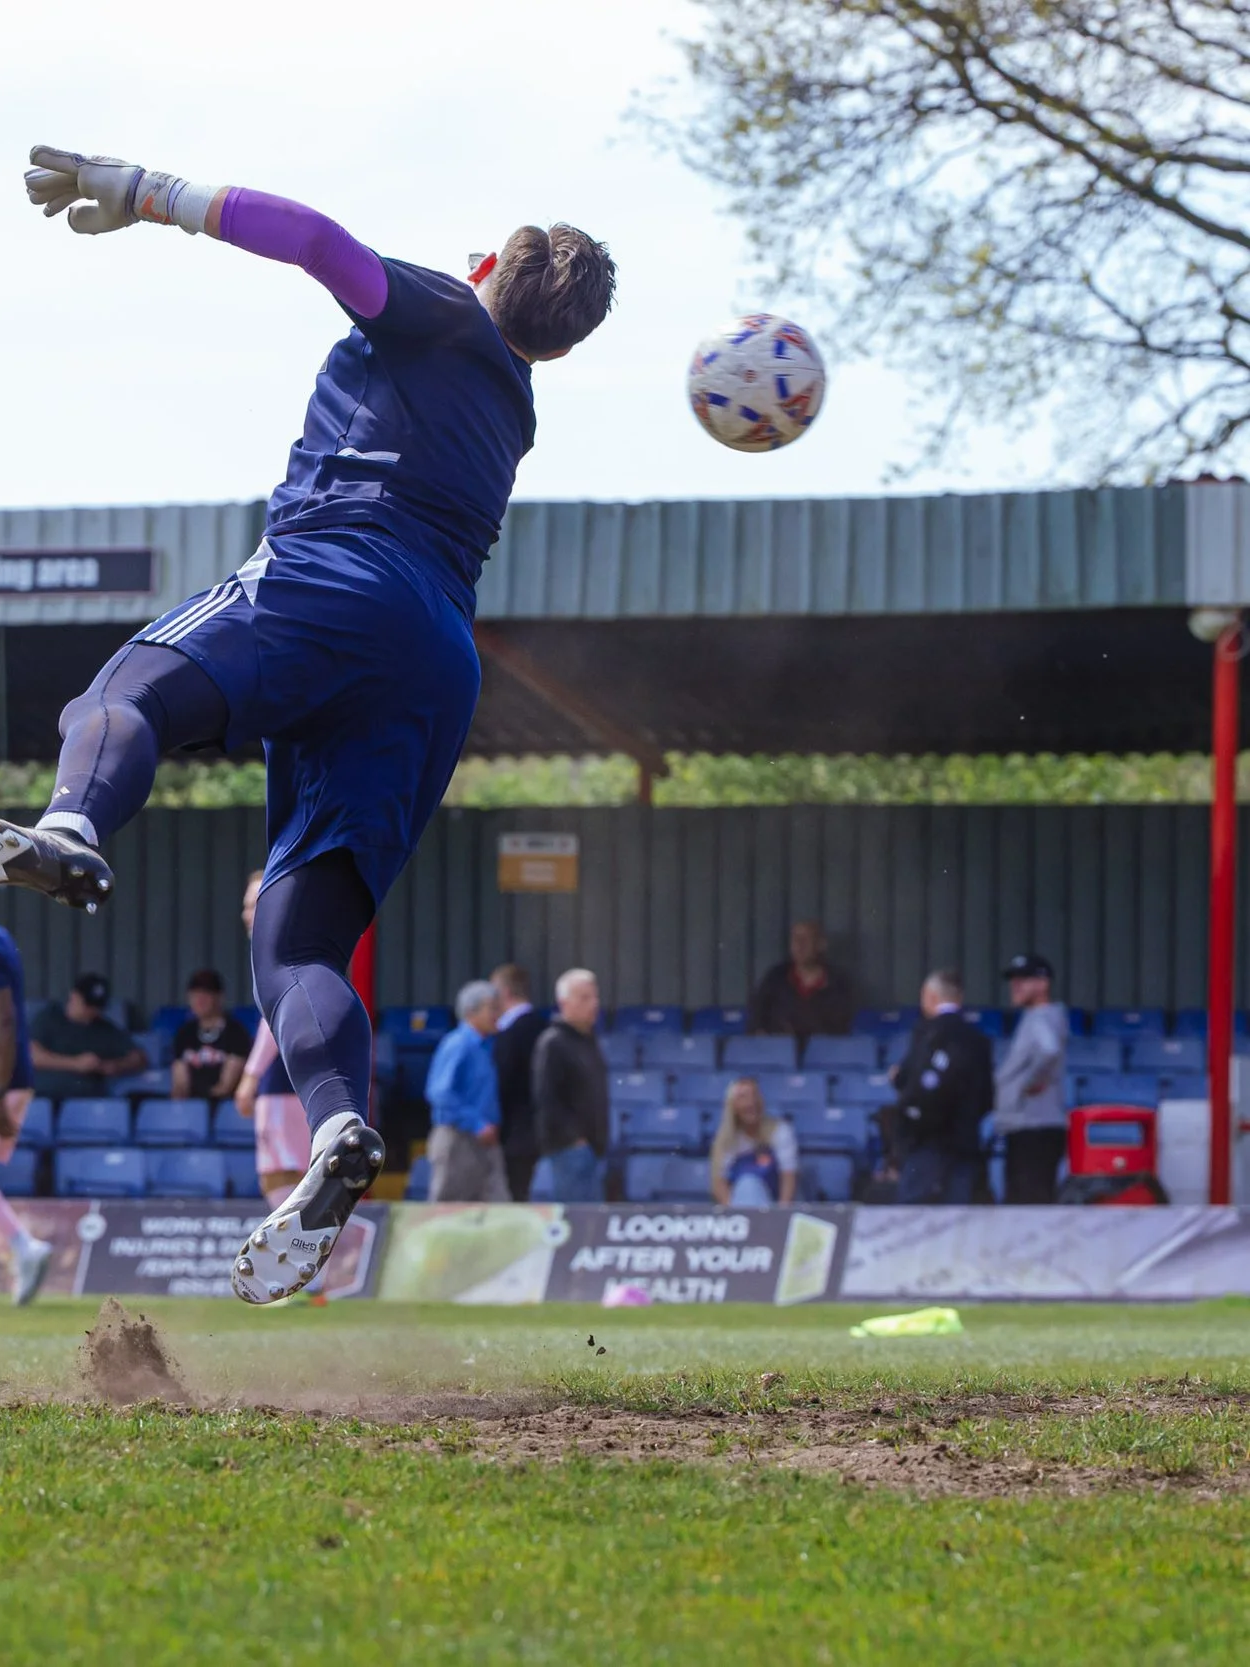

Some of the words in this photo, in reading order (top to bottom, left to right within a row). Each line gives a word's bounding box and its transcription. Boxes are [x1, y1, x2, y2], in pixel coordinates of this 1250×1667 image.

[36, 557, 100, 588] area
[607, 1215, 750, 1241] LOOKING
[570, 1245, 676, 1272] AFTER
[685, 1245, 773, 1272] YOUR
